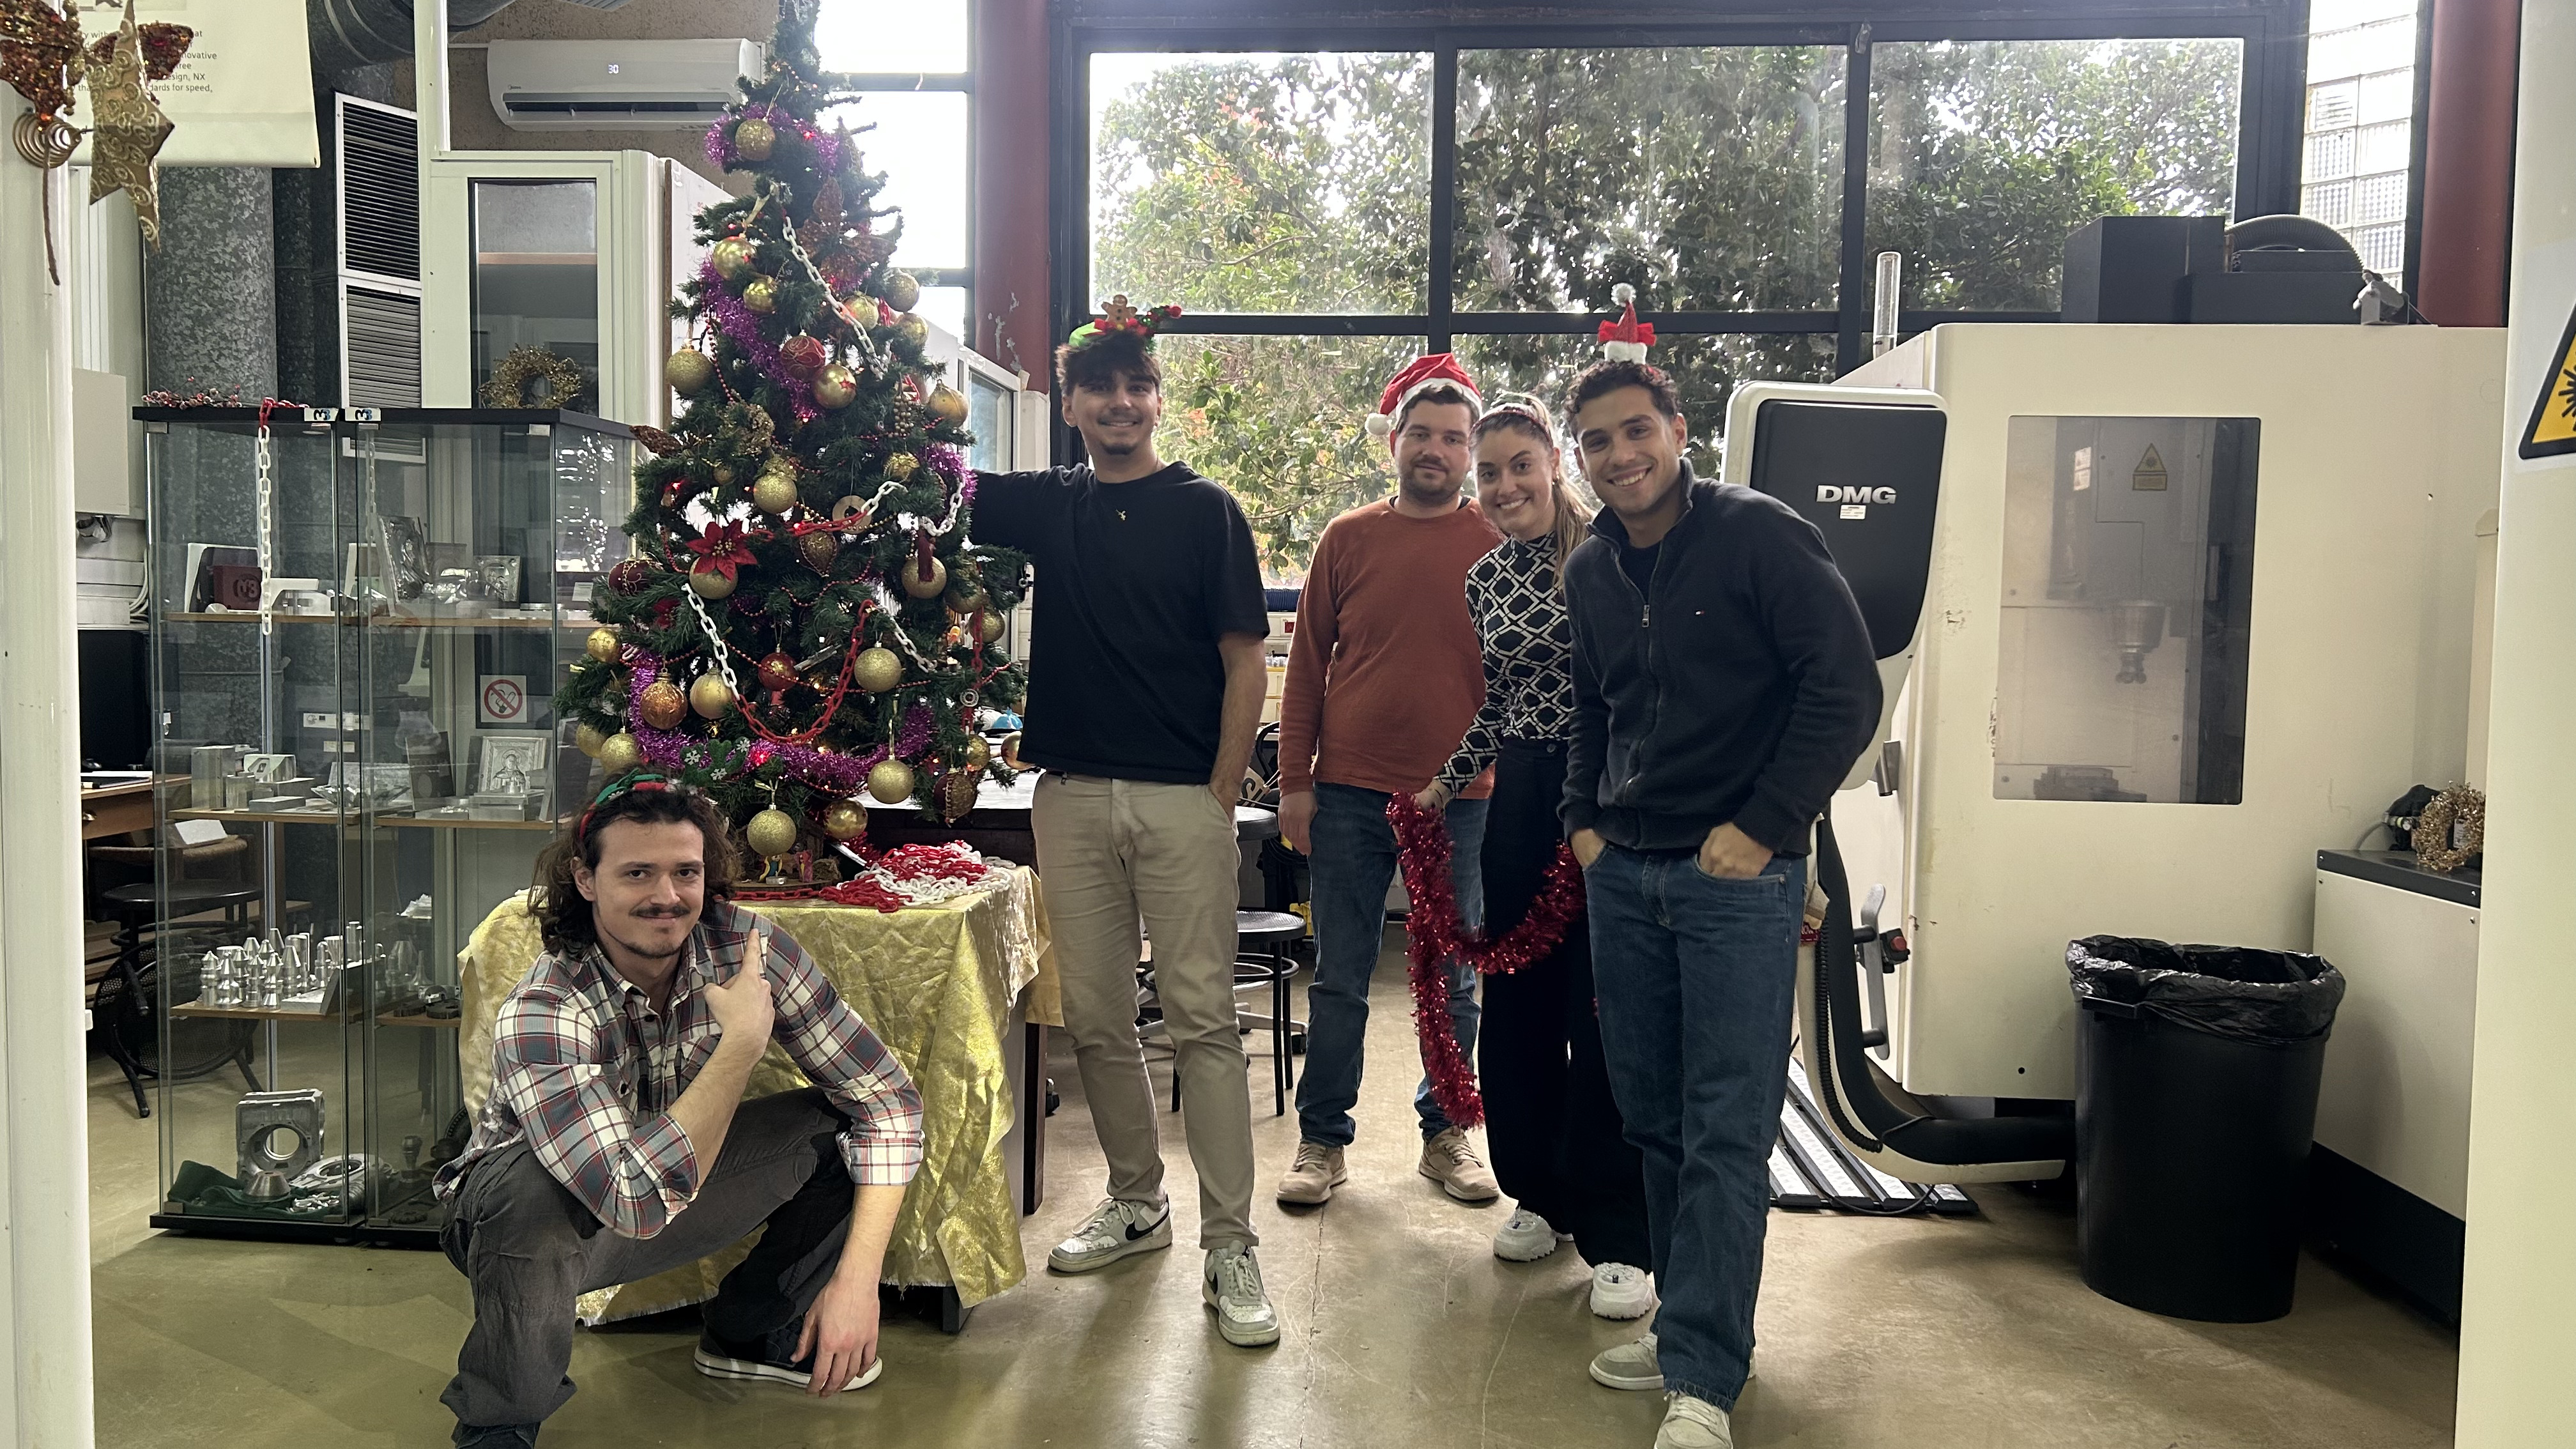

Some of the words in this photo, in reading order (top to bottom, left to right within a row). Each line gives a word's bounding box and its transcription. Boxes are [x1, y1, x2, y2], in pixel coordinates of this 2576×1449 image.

[170, 72, 190, 82] sign,
[172, 83, 183, 91] for
[1816, 484, 1897, 504] DMG
